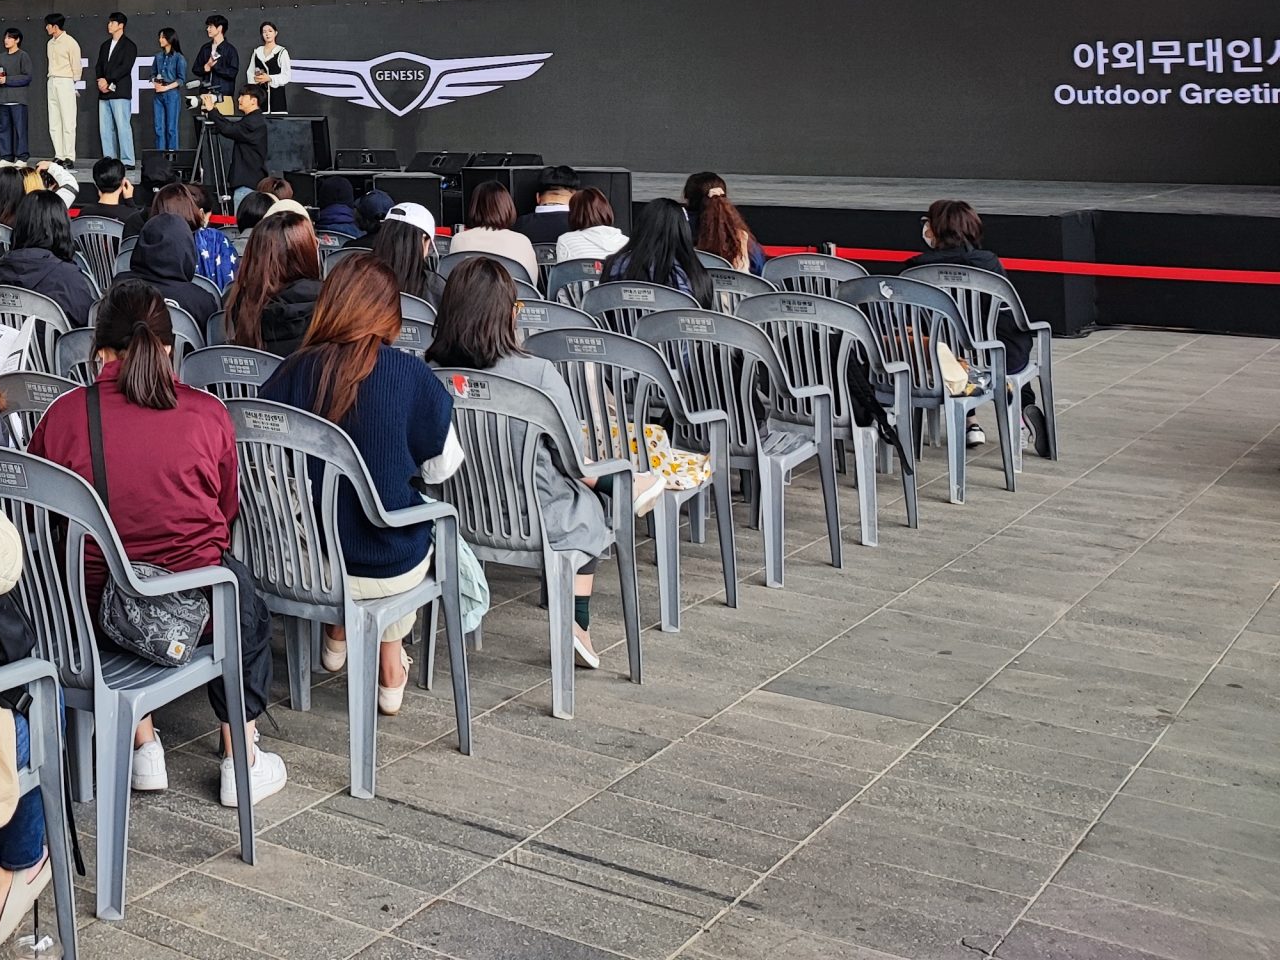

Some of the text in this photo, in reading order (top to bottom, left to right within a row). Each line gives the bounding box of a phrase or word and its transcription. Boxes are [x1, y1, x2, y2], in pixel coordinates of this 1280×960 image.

[1073, 38, 1280, 75] 야외무대인
[375, 70, 425, 81] GENESIS
[1053, 84, 1172, 105] Outdoor
